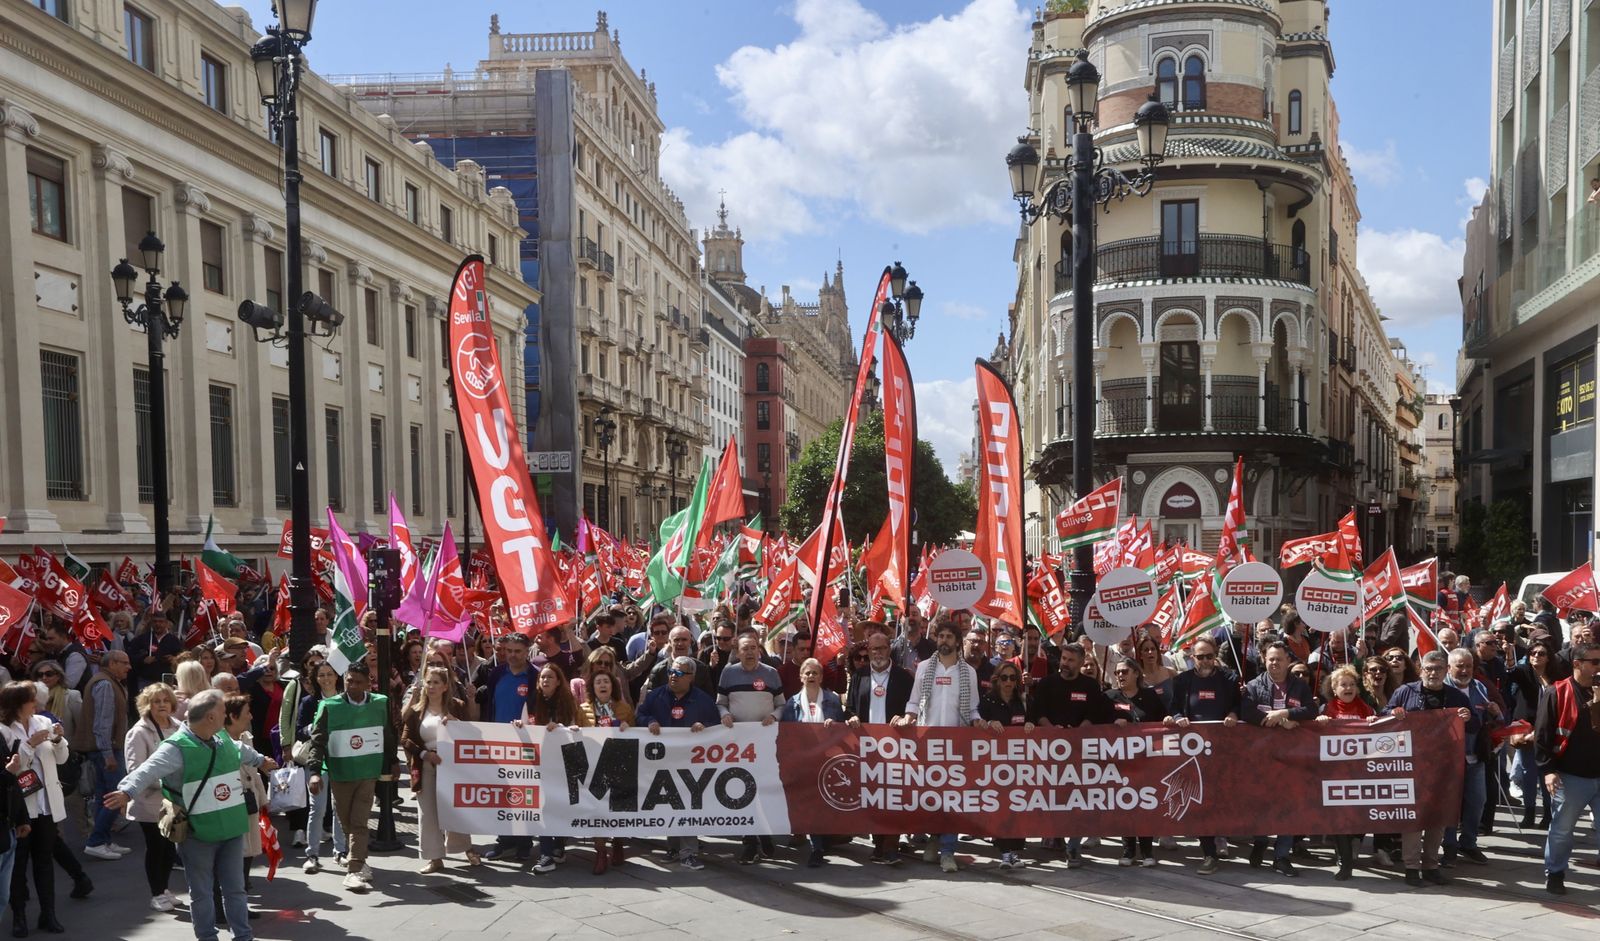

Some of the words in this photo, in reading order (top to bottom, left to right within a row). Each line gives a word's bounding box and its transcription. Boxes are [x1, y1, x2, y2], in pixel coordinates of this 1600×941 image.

[455, 263, 477, 302] UGT
[475, 408, 542, 592] UGT
[933, 571, 966, 581] CCOO
[99, 581, 126, 605] UGT
[938, 581, 976, 593] hábitat
[1102, 588, 1136, 601] CCOO
[1228, 584, 1262, 593] CCOO
[1231, 595, 1270, 605] hábitat
[1304, 590, 1340, 601] CCOO
[509, 601, 538, 619] UGT
[1042, 596, 1058, 627] Sevilla
[1108, 597, 1148, 612] hábitat
[1307, 602, 1348, 615] hábitat
[517, 612, 557, 628] Sevilla
[690, 742, 757, 764] 2024
[859, 736, 918, 760] POR
[926, 738, 963, 761] EL
[971, 738, 1072, 761] PLENO
[1081, 731, 1212, 760] EMPLEO:
[1326, 737, 1373, 757] UGT
[1366, 759, 1413, 772] Sevilla
[497, 767, 541, 780] Sevilla
[859, 761, 967, 787] MENOS
[975, 761, 1130, 787] JORNADA,
[461, 786, 503, 804] UGT
[859, 786, 1000, 813] MEJORES
[1008, 785, 1159, 812] SALARIOS
[497, 809, 540, 822] Sevilla
[1368, 807, 1416, 821] Sevilla
[570, 817, 665, 829] #PLENOEMPLEO
[668, 816, 675, 828] /
[677, 816, 755, 828] #1MAYO2024
